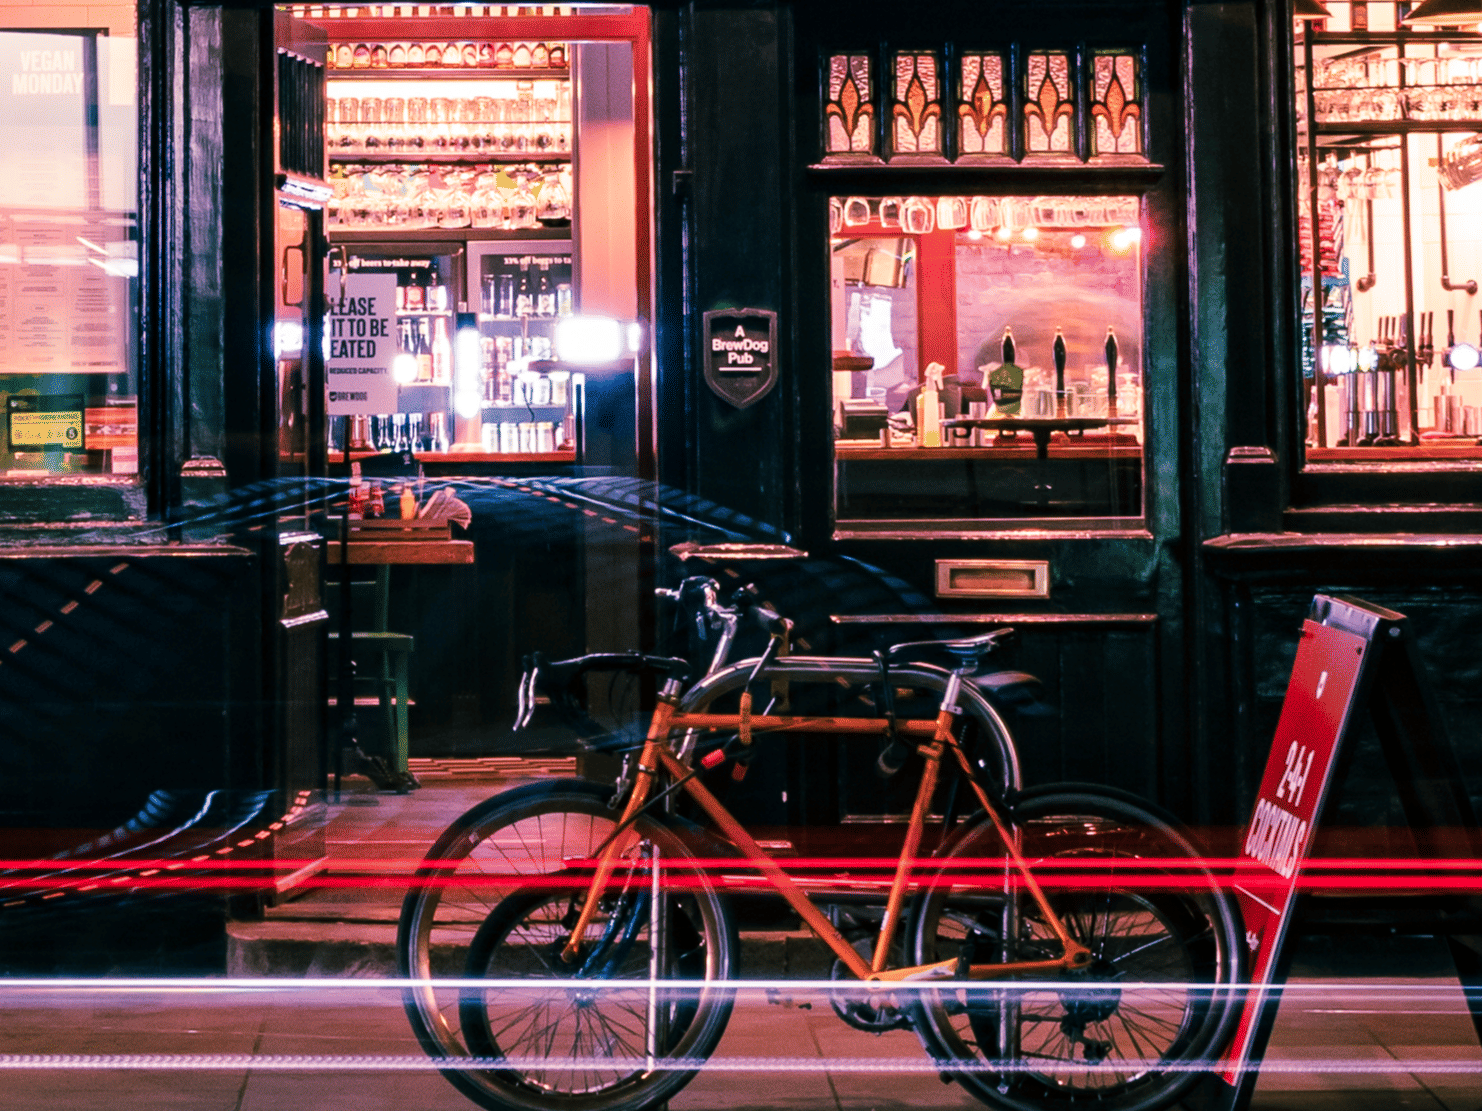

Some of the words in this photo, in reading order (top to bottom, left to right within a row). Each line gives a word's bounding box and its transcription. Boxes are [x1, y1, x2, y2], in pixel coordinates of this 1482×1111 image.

[20, 50, 74, 72] VEGAN
[12, 73, 85, 94] MONDAY
[330, 297, 376, 316] LEASE
[347, 318, 366, 337] TO
[370, 318, 389, 337] BE
[734, 325, 746, 338] A
[331, 340, 376, 358] EATED
[712, 338, 769, 354] BrewDog
[727, 352, 754, 365] Pub
[1245, 798, 1307, 880] COCKTAILS
